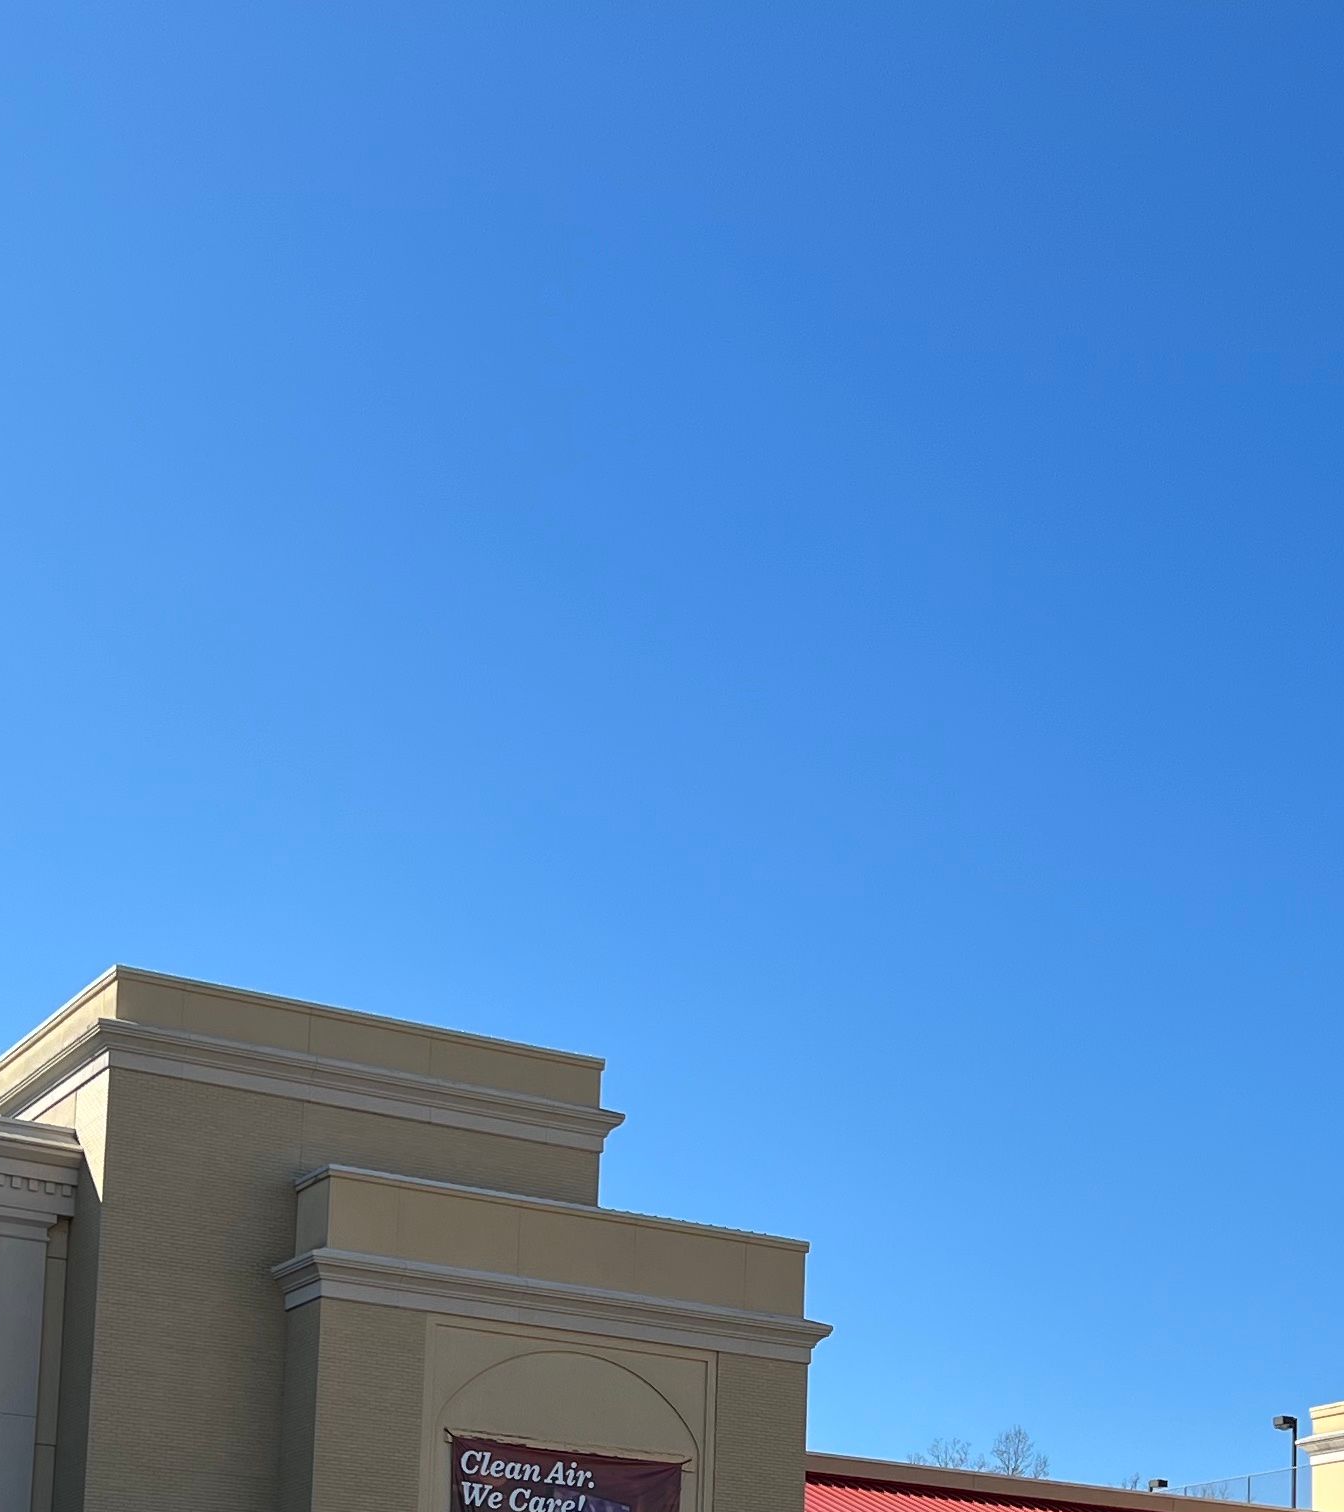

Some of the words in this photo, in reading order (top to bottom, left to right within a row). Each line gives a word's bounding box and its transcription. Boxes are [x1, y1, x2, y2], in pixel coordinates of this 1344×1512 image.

[460, 1450, 542, 1483] Clean
[544, 1461, 596, 1488] Air.
[461, 1482, 502, 1509] We
